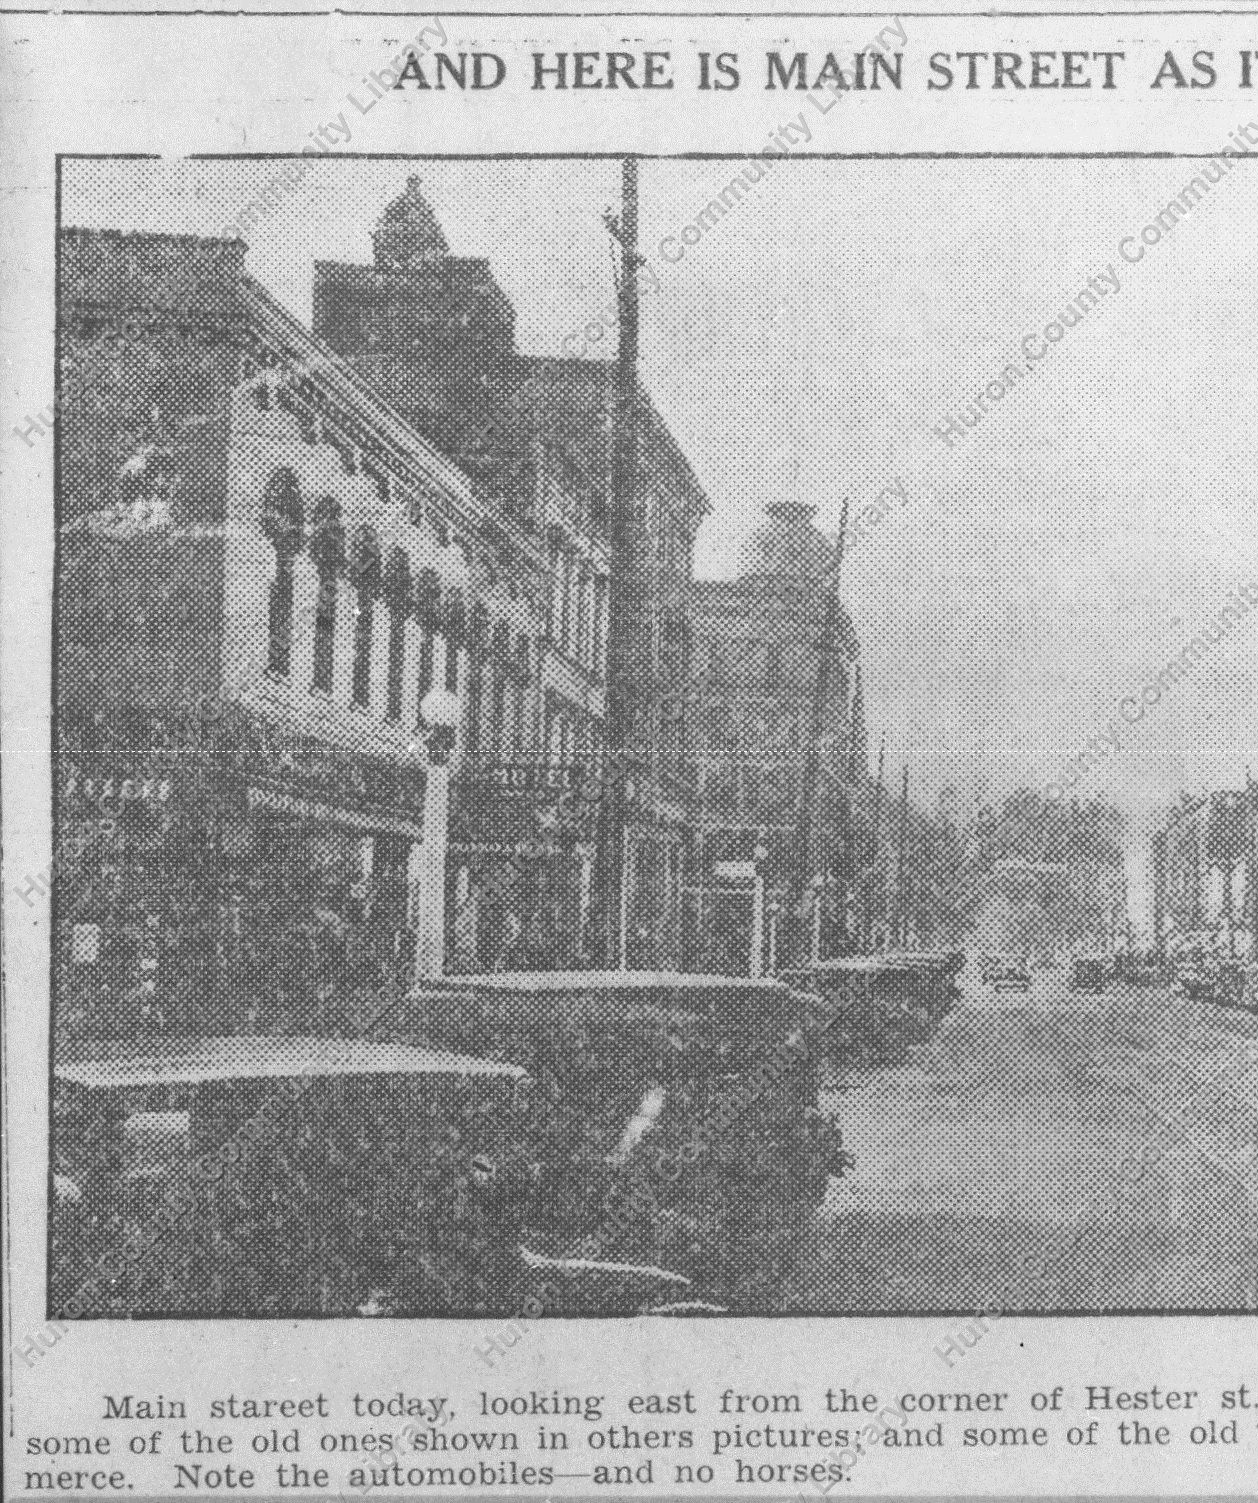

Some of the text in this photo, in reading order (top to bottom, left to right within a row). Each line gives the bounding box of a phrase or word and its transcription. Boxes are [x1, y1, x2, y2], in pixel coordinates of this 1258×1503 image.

[394, 51, 506, 90] AND
[532, 52, 673, 90] HERE
[698, 52, 740, 91] IS
[765, 52, 902, 90] MAIN
[927, 51, 1126, 90] STREET
[1150, 50, 1218, 89] AS
[103, 1395, 187, 1420] Main
[210, 1394, 329, 1419] stareet
[353, 1393, 456, 1423] today,
[479, 1391, 605, 1422] looking
[627, 1391, 698, 1414] east
[719, 1389, 802, 1414] from
[825, 1388, 879, 1413] the
[899, 1393, 1009, 1412] corner
[1030, 1386, 1064, 1411] of
[1085, 1385, 1198, 1411] Hester
[26, 1437, 112, 1455] some
[129, 1430, 163, 1455] of
[180, 1430, 234, 1454] the
[251, 1429, 301, 1453] old
[320, 1433, 395, 1453] ones
[412, 1427, 519, 1452] shown
[538, 1426, 569, 1450] in
[587, 1425, 695, 1450] others
[713, 1424, 863, 1455] pictures;
[883, 1423, 944, 1447] and
[963, 1428, 1048, 1446] some
[1066, 1421, 1100, 1445] of
[1118, 1421, 1171, 1446] the
[1190, 1420, 1238, 1444] old
[25, 1471, 136, 1491] merce.
[174, 1464, 256, 1489] Note
[276, 1463, 330, 1488] the
[675, 1465, 715, 1484] no
[735, 1458, 853, 1483] horses.
